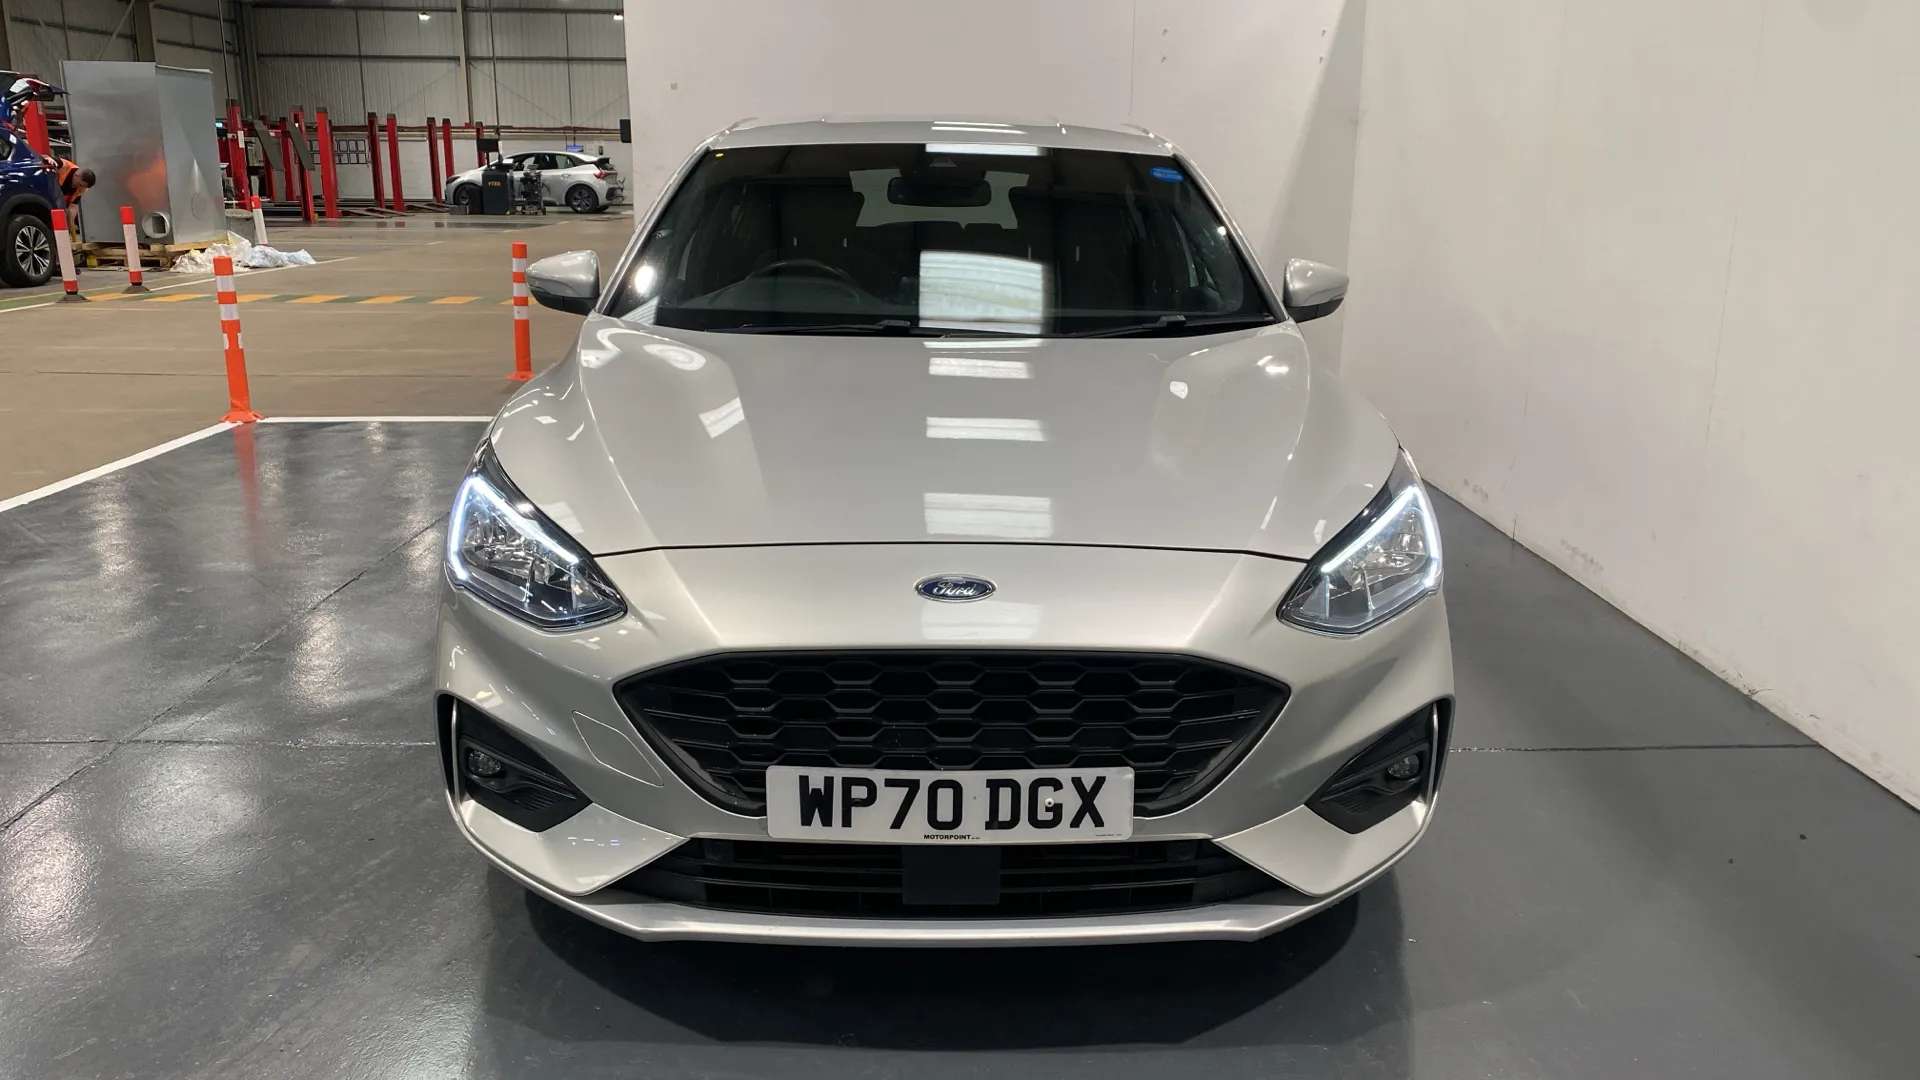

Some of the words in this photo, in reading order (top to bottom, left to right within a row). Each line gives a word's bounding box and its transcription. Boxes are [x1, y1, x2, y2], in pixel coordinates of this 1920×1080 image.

[932, 581, 977, 596] Ford
[798, 775, 963, 830] WP70
[985, 776, 1107, 830] DGX
